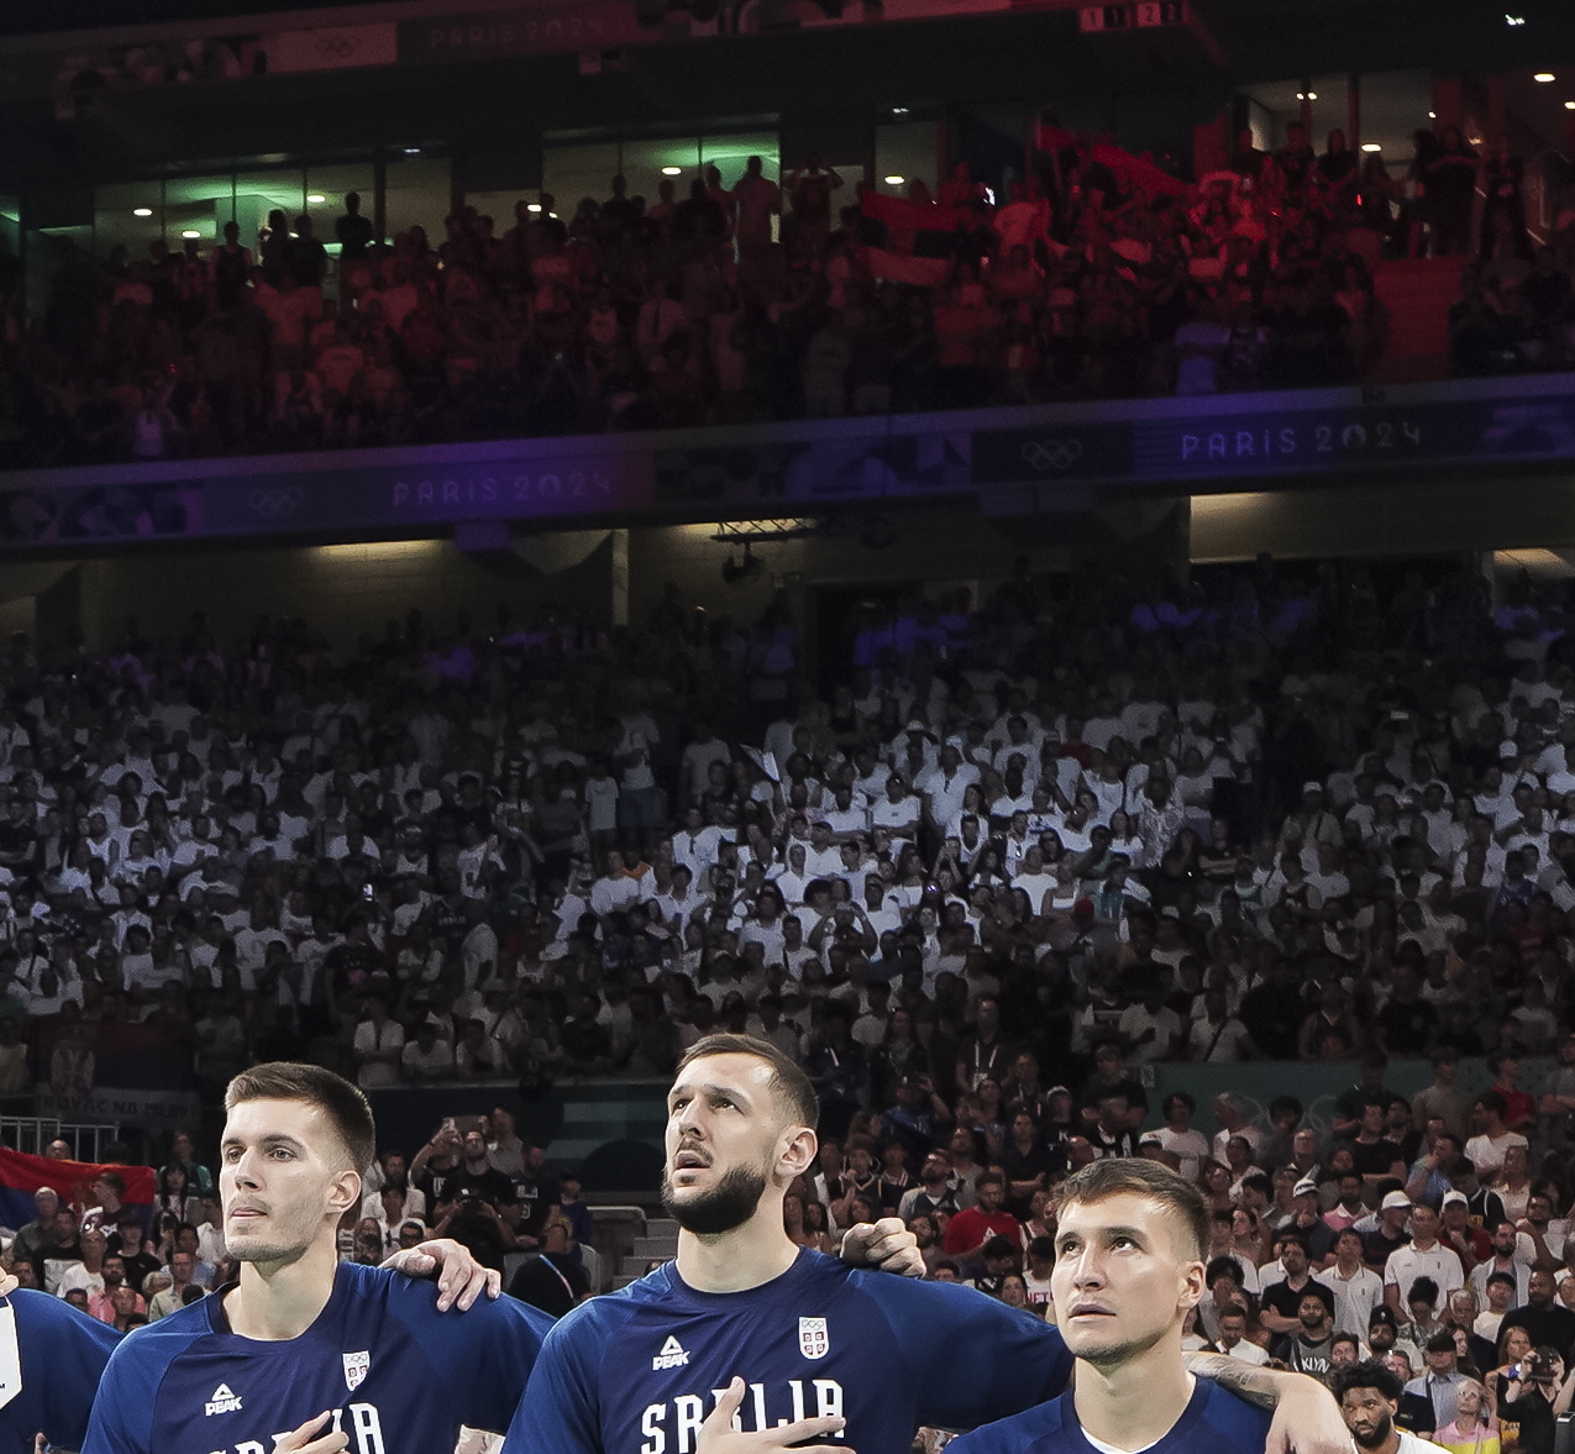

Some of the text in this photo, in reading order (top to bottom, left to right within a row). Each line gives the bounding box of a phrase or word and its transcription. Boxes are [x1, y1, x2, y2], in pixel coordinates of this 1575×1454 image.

[1182, 422, 1420, 463] PARIS 2024
[394, 473, 610, 508] PARIS 2024
